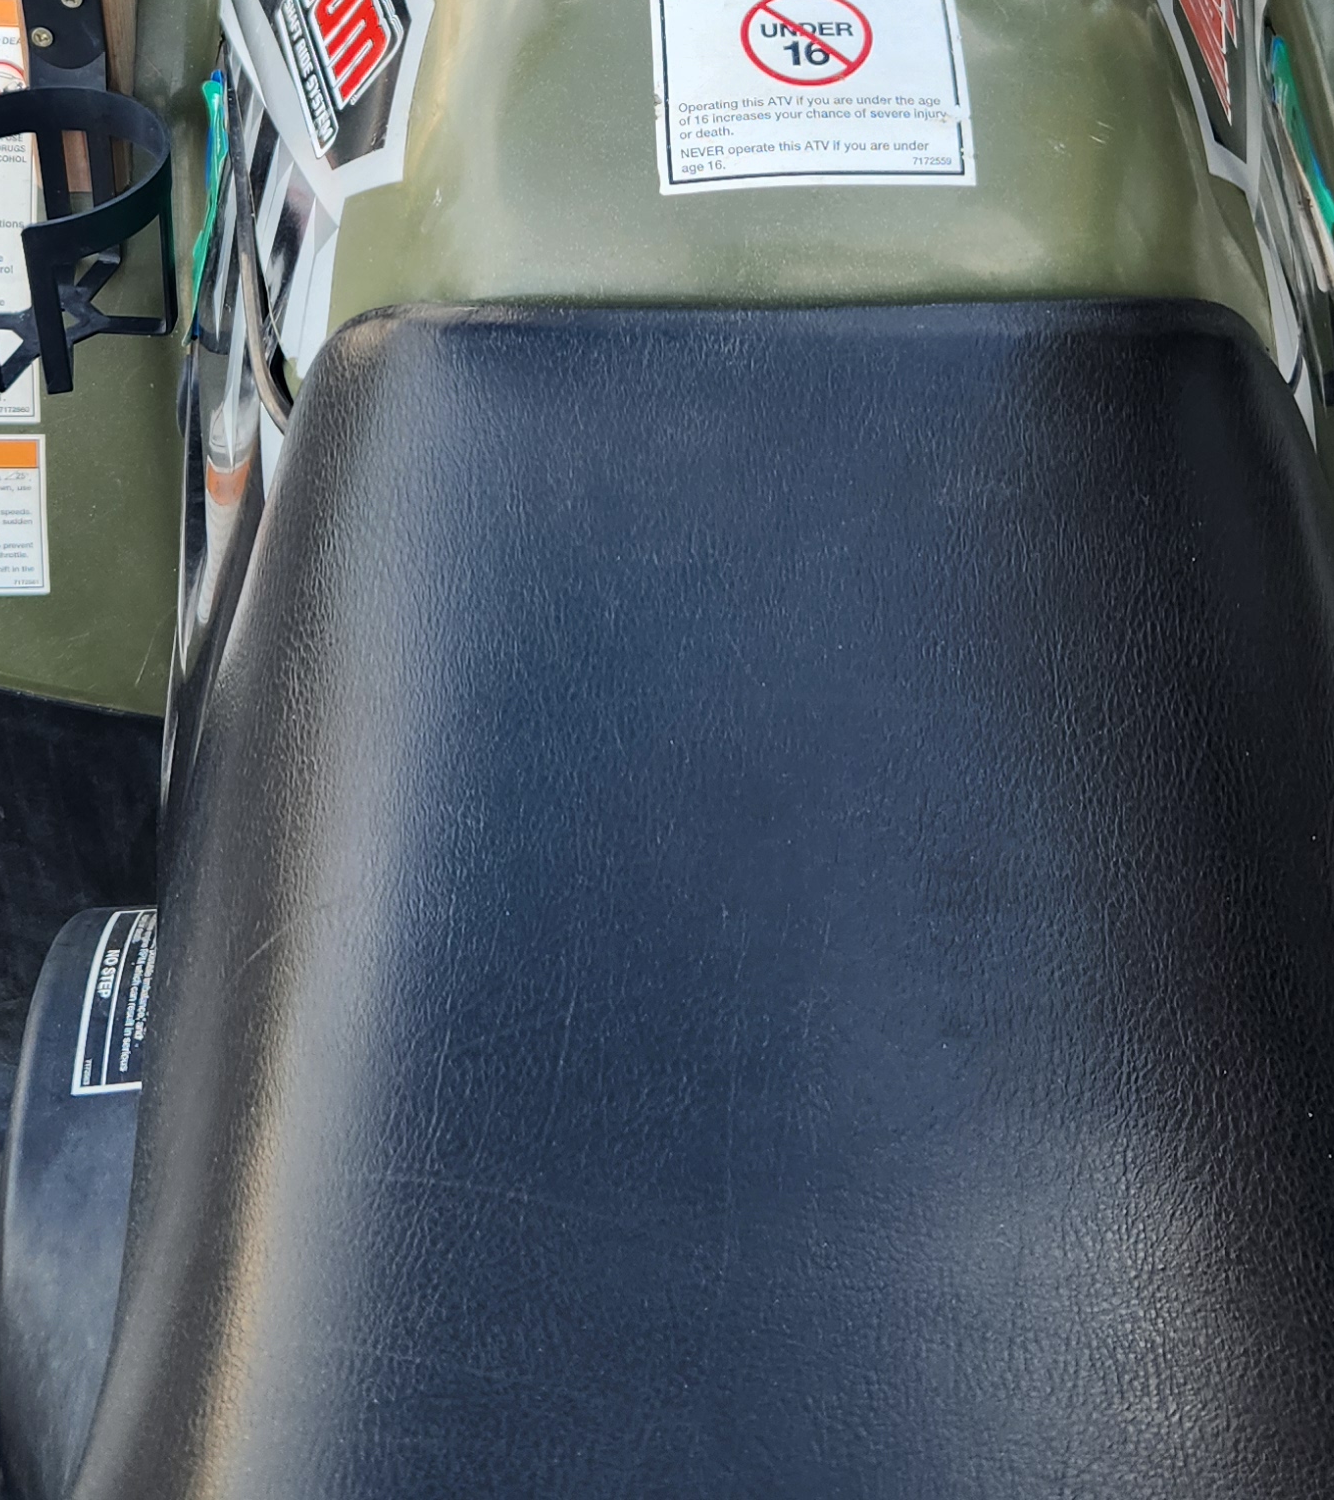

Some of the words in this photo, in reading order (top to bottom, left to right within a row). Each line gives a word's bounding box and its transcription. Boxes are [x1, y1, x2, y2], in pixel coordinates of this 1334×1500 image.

[760, 22, 854, 38] UNDER
[783, 40, 831, 66] 16
[294, 38, 313, 79] RIDE
[305, 74, 333, 142] SYSTEM
[679, 101, 738, 114] Operating
[742, 98, 764, 108] this
[768, 96, 792, 106] ATV
[796, 96, 803, 105] if
[807, 98, 829, 107] you
[857, 95, 892, 105] under
[895, 96, 915, 105] the
[918, 98, 941, 107] age
[679, 115, 691, 126] of
[695, 115, 709, 124] 16
[713, 112, 771, 123] increases
[775, 112, 803, 121] your
[806, 108, 851, 118] chance
[855, 109, 866, 118] of
[870, 110, 911, 118] severe
[680, 131, 693, 139] or
[696, 126, 734, 138] death.
[681, 145, 724, 158] NEVER
[728, 143, 775, 156] operate
[779, 141, 801, 151] this
[805, 140, 830, 151] ATV
[833, 140, 841, 150] if
[844, 142, 866, 153] you
[870, 142, 889, 151] are
[893, 140, 929, 150] under
[682, 163, 705, 174] age
[709, 160, 726, 170] 16.
[913, 157, 952, 165] 7172559
[104, 949, 120, 966] NO
[97, 967, 116, 999] STEP
